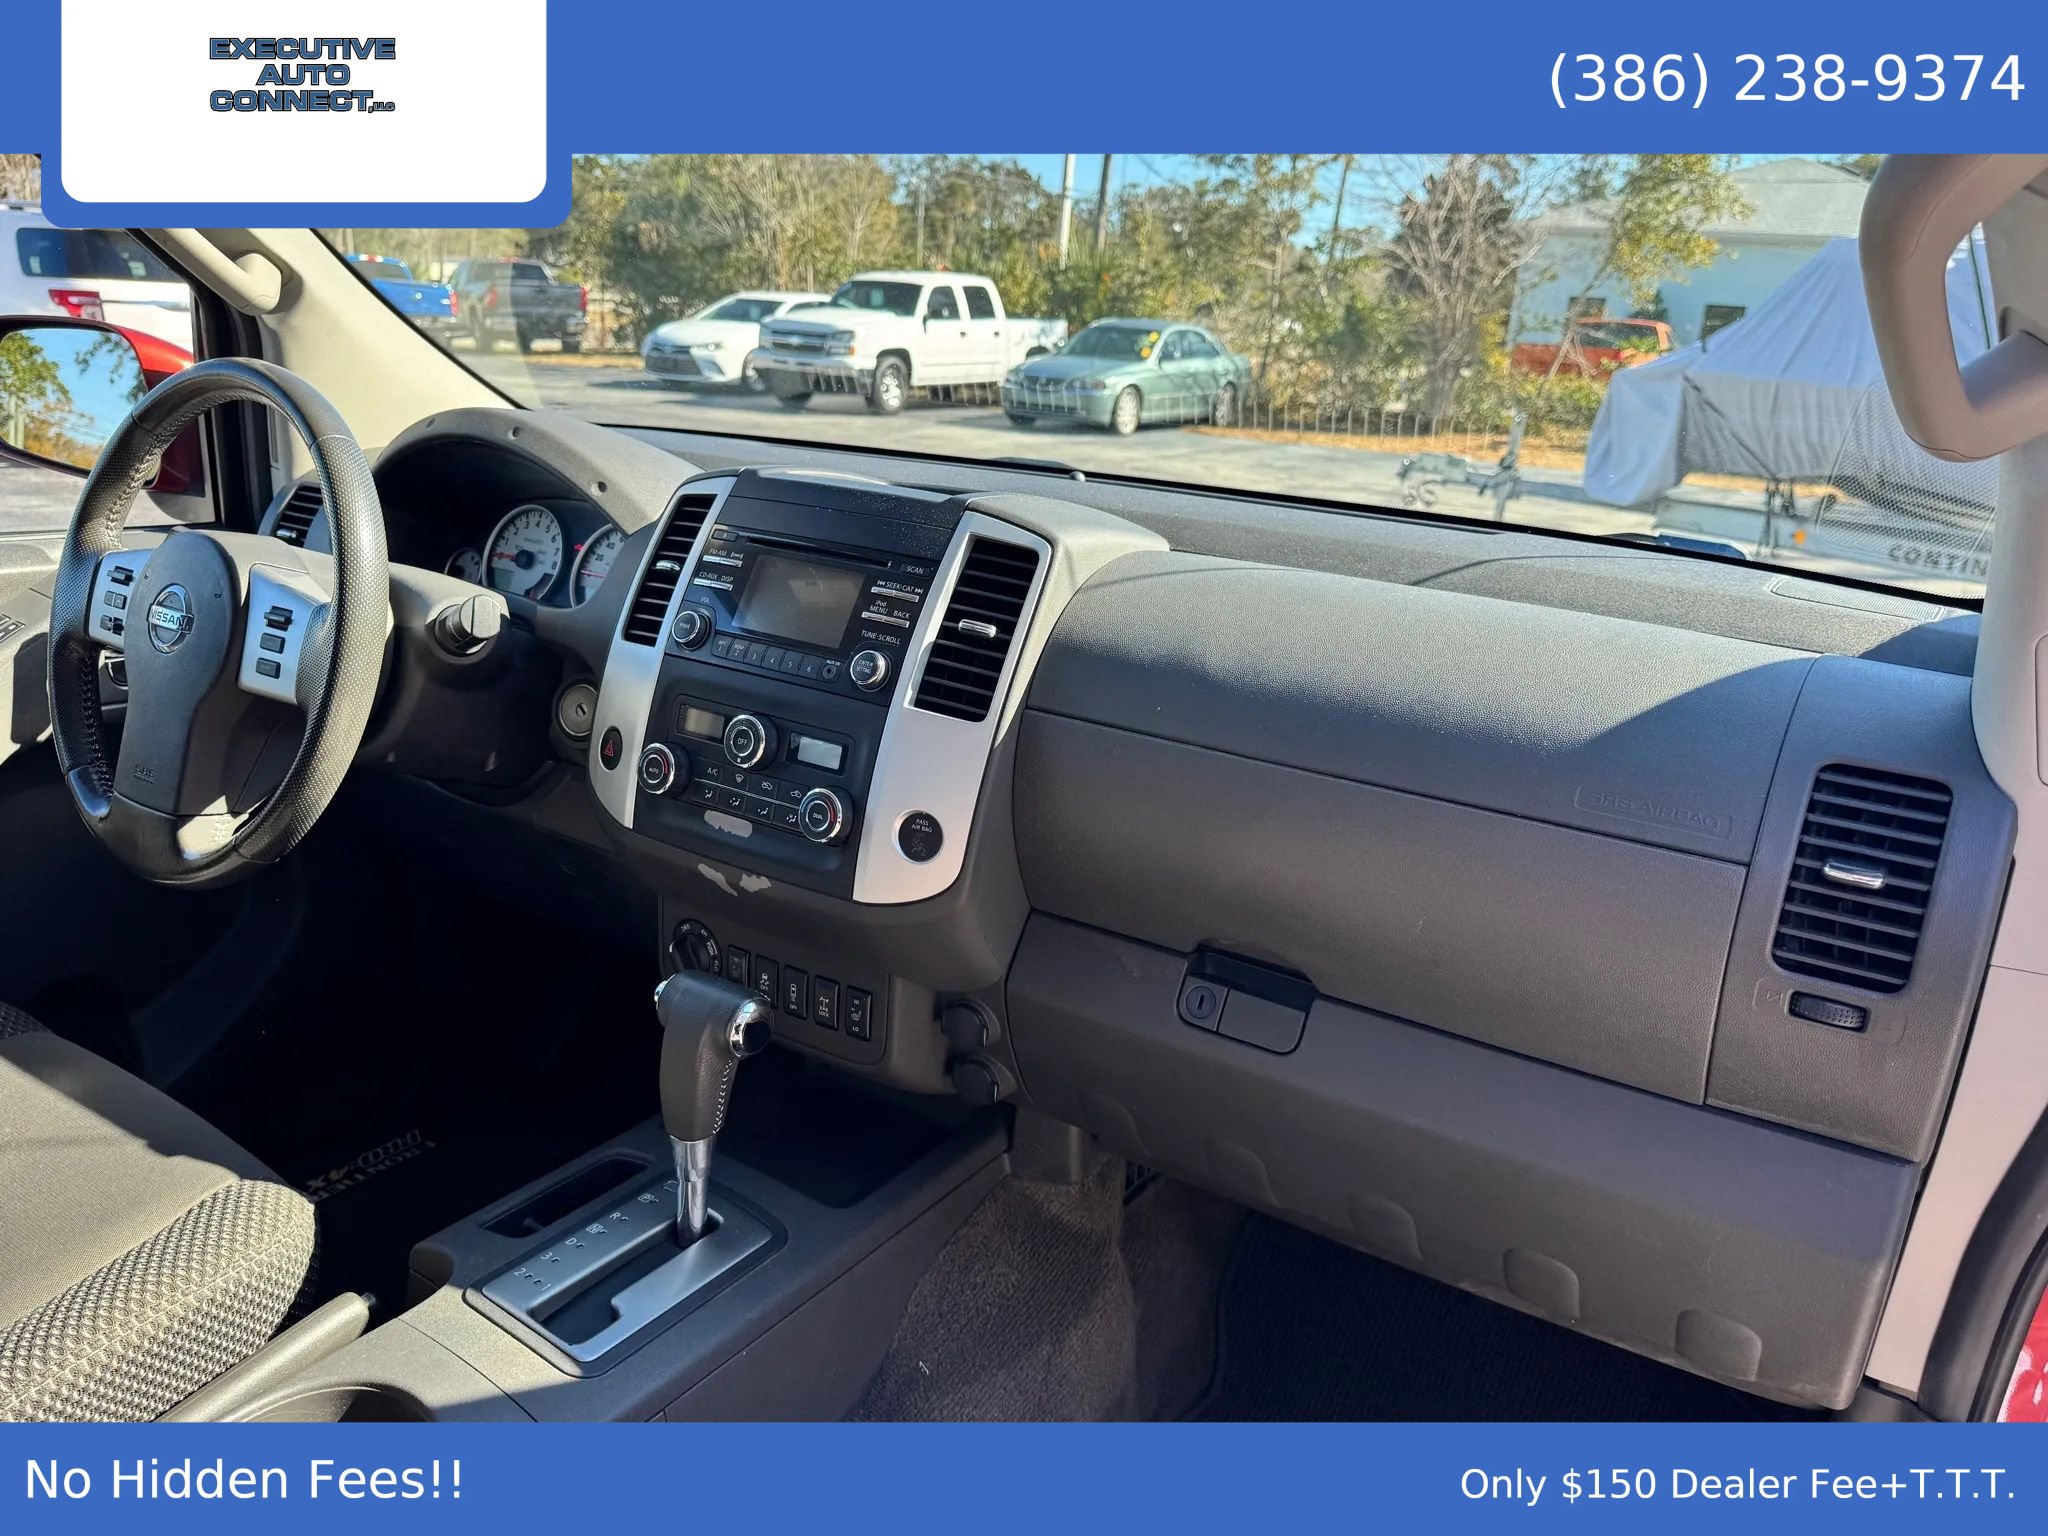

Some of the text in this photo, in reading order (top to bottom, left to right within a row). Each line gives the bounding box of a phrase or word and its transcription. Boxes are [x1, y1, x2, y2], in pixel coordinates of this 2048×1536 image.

[906, 565, 925, 575] SCAN
[151, 607, 186, 627] NISSAN
[869, 605, 912, 619] MENU BACK
[737, 737, 749, 746] OFF
[648, 766, 659, 775] AUTO
[707, 766, 718, 777] A/C
[916, 818, 929, 827] PASS
[818, 1010, 830, 1018] LOCK
[609, 1211, 621, 1221] R
[565, 1237, 577, 1246] D
[540, 1251, 553, 1261] 3
[513, 1267, 527, 1277] 2
[541, 1283, 552, 1291] 1
